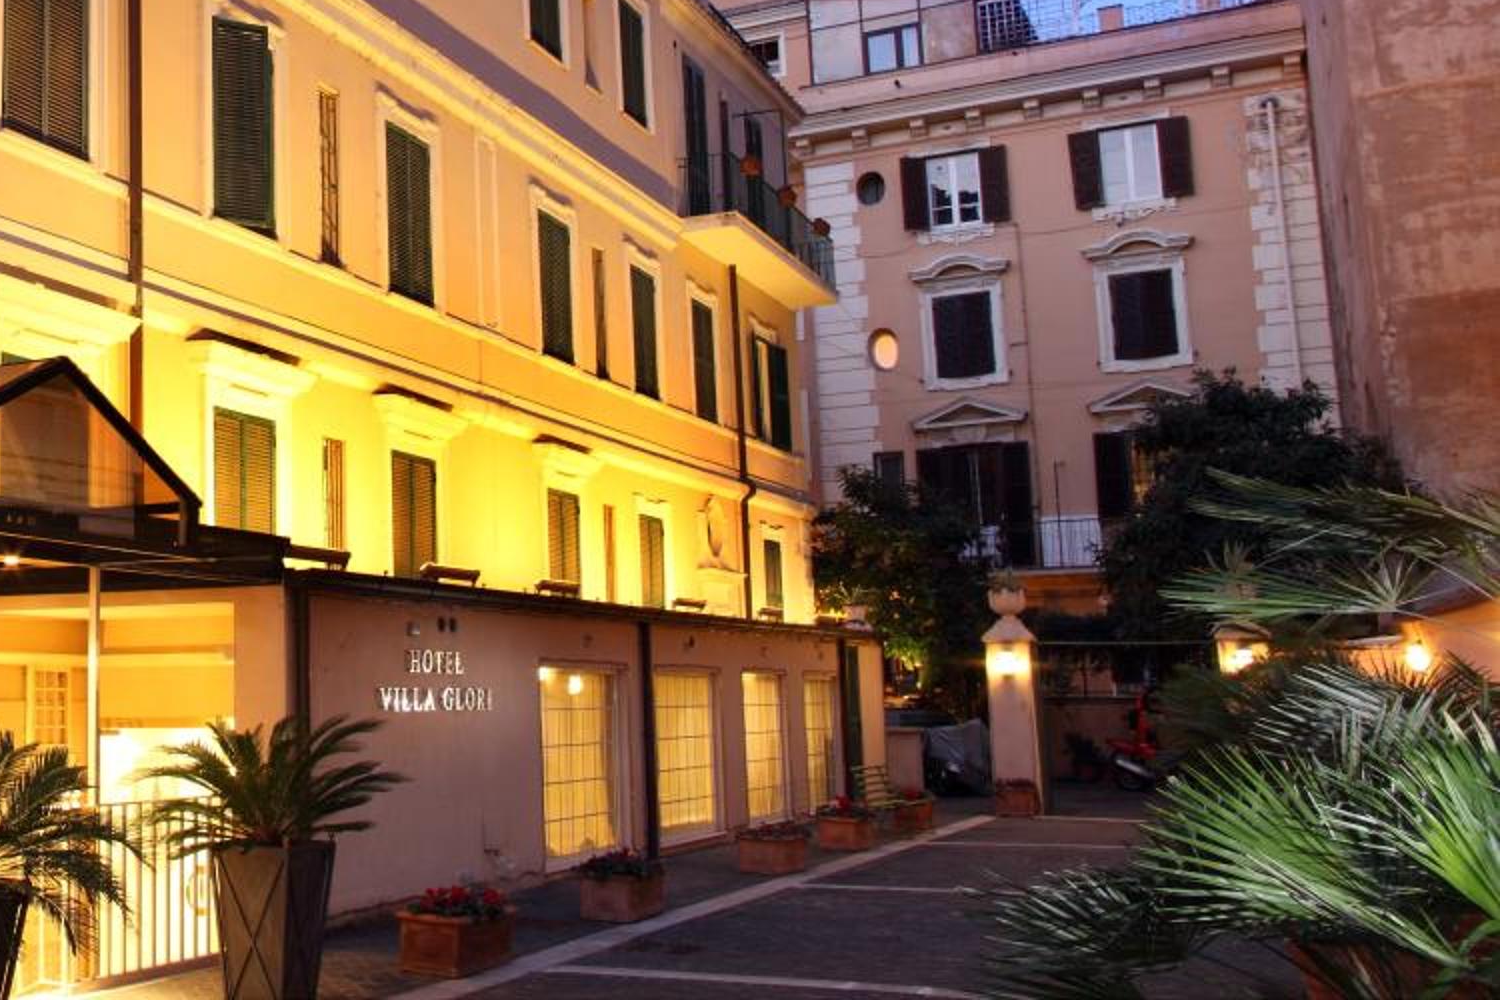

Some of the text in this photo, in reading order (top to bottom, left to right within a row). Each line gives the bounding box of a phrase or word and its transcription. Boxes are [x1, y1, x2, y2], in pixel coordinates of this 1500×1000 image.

[409, 649, 464, 675] HOTEL
[379, 687, 493, 712] VILLA GLORI
